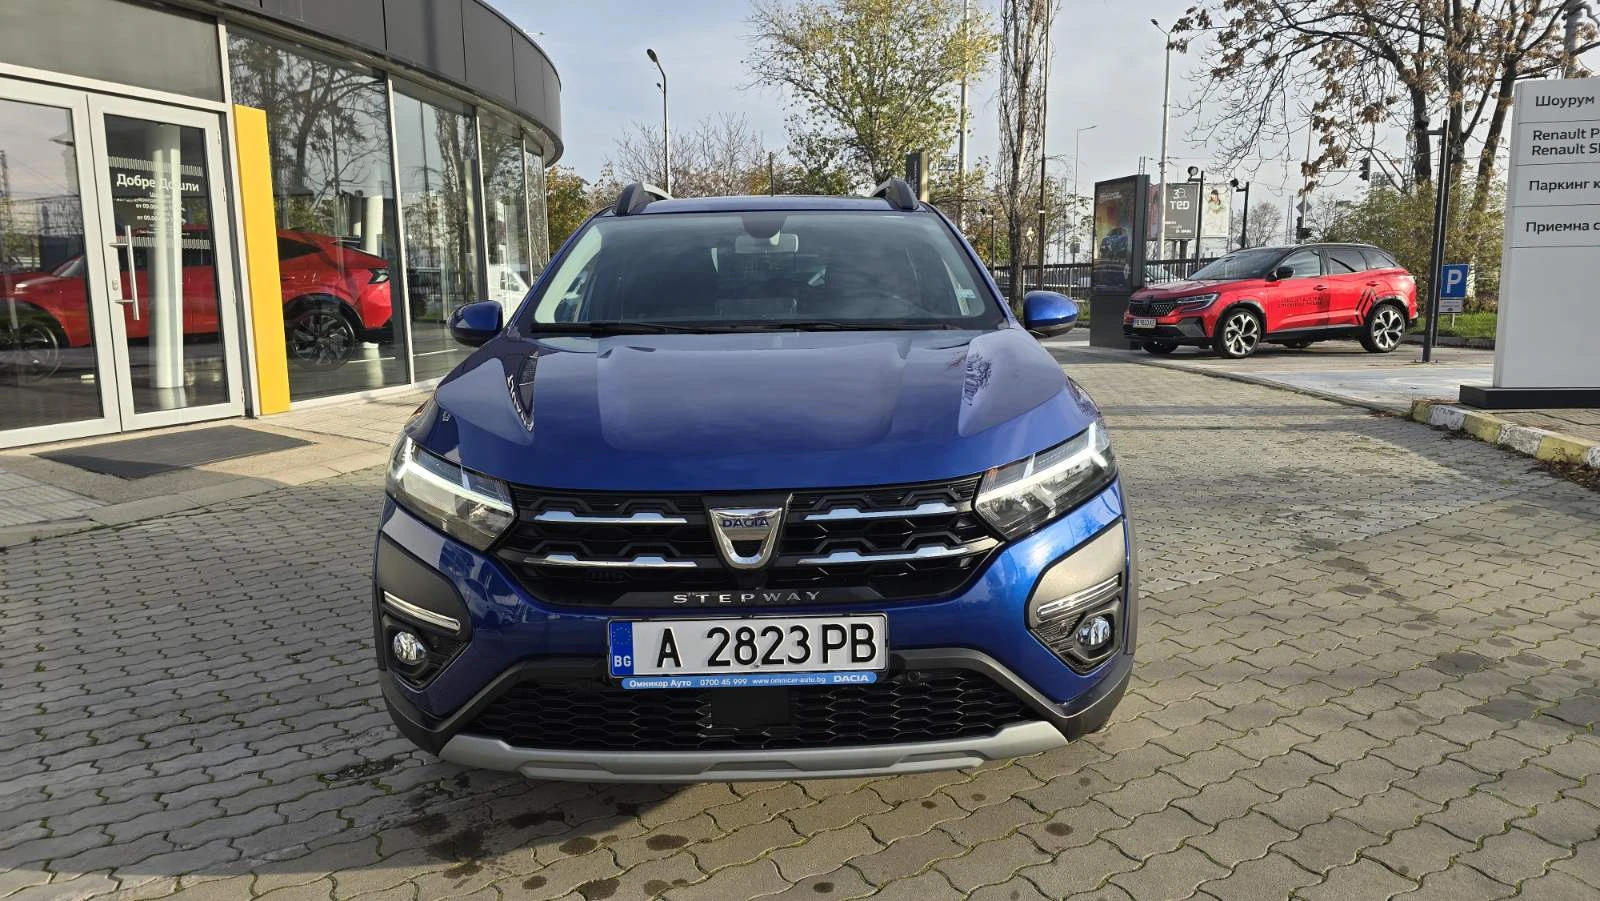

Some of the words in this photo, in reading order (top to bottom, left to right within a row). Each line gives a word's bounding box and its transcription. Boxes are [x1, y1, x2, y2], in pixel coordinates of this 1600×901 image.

[1535, 95, 1595, 109] Шоурум
[1533, 128, 1587, 141] Renault
[1532, 143, 1586, 156] Renault
[1589, 142, 1600, 154] S
[116, 173, 156, 189] Добре
[1529, 180, 1590, 193] Паркинг
[1526, 221, 1590, 235] Приемна
[1446, 269, 1462, 294] P
[722, 518, 770, 529] DACIA
[672, 591, 821, 604] STEPWAY
[613, 655, 632, 668] BG
[656, 628, 682, 668] A
[706, 625, 812, 668] 2823
[820, 623, 877, 664] PB
[670, 679, 692, 688] Ауто
[699, 679, 720, 687] 0700
[721, 679, 731, 687] 45
[733, 678, 748, 687] 999
[833, 674, 869, 682] DACIA
